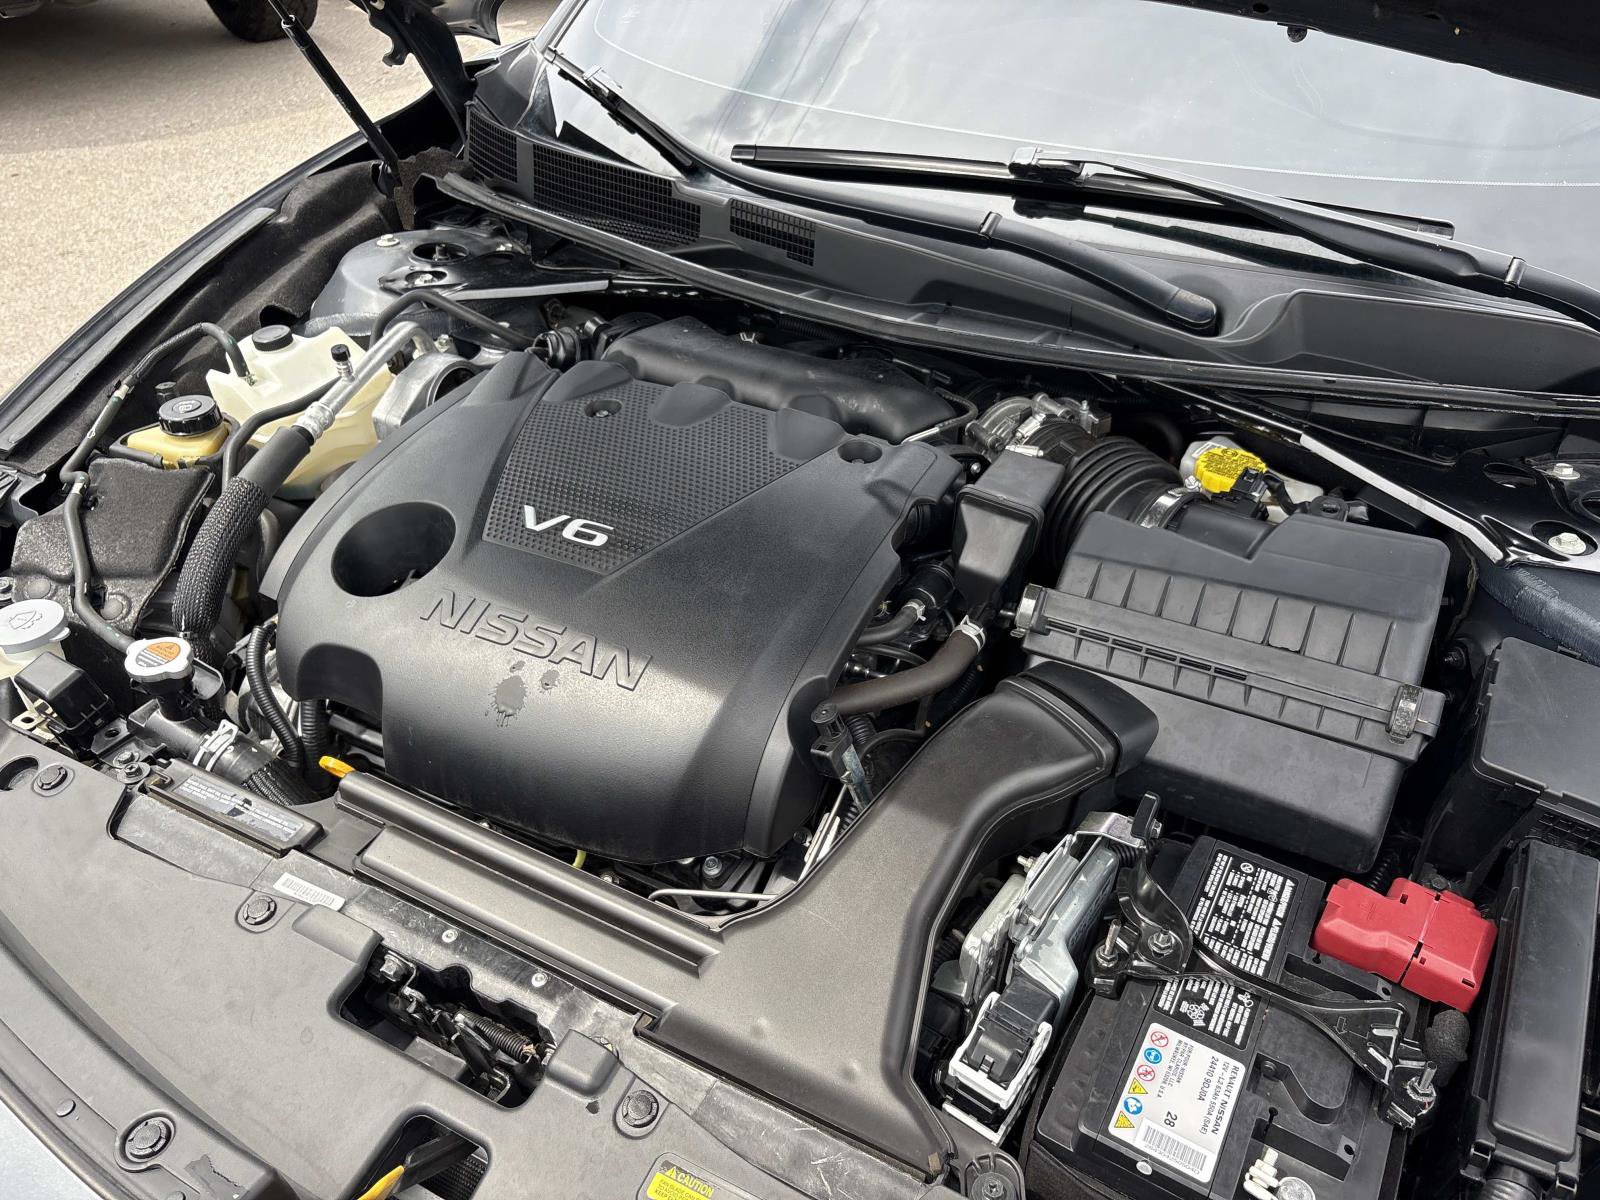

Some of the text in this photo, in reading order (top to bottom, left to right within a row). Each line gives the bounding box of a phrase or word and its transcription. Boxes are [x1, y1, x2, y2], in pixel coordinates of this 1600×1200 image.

[523, 504, 615, 547] V6
[419, 588, 653, 691] NISSAN
[1206, 1056, 1219, 1078] 24410
[1211, 1065, 1240, 1135] RENAULT NISSAN
[1163, 1110, 1178, 1128] 28
[1199, 1115, 1211, 1135] (SAE)
[654, 1188, 668, 1198] KEEP
[676, 1172, 715, 1198] CAUTION
